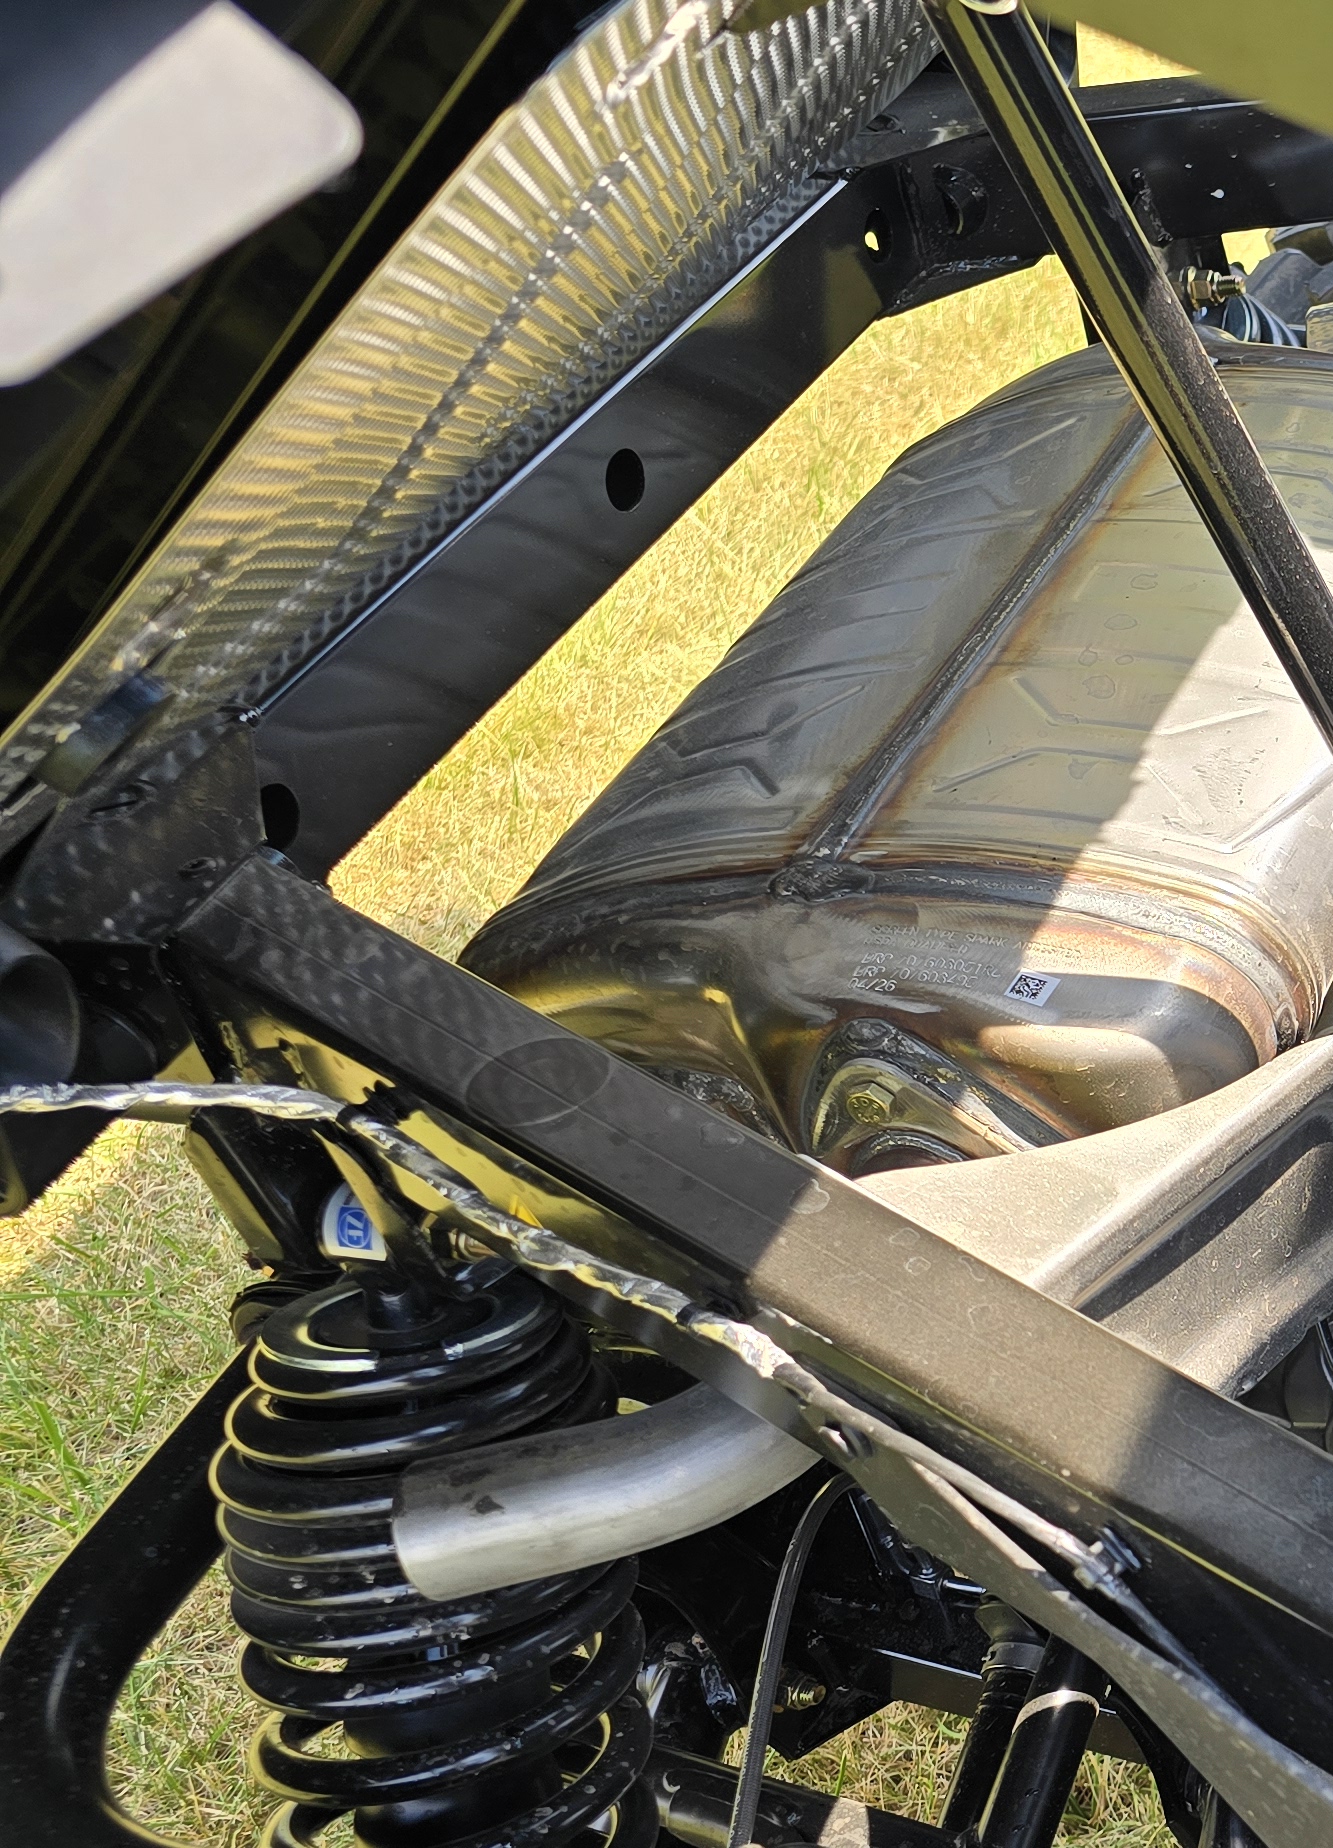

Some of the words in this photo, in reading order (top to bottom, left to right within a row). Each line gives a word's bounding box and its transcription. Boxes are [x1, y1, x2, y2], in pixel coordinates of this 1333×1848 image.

[926, 927, 959, 942] TYPE
[964, 932, 1011, 949] SPARK
[860, 952, 894, 965] BRP
[852, 965, 887, 979] BRP
